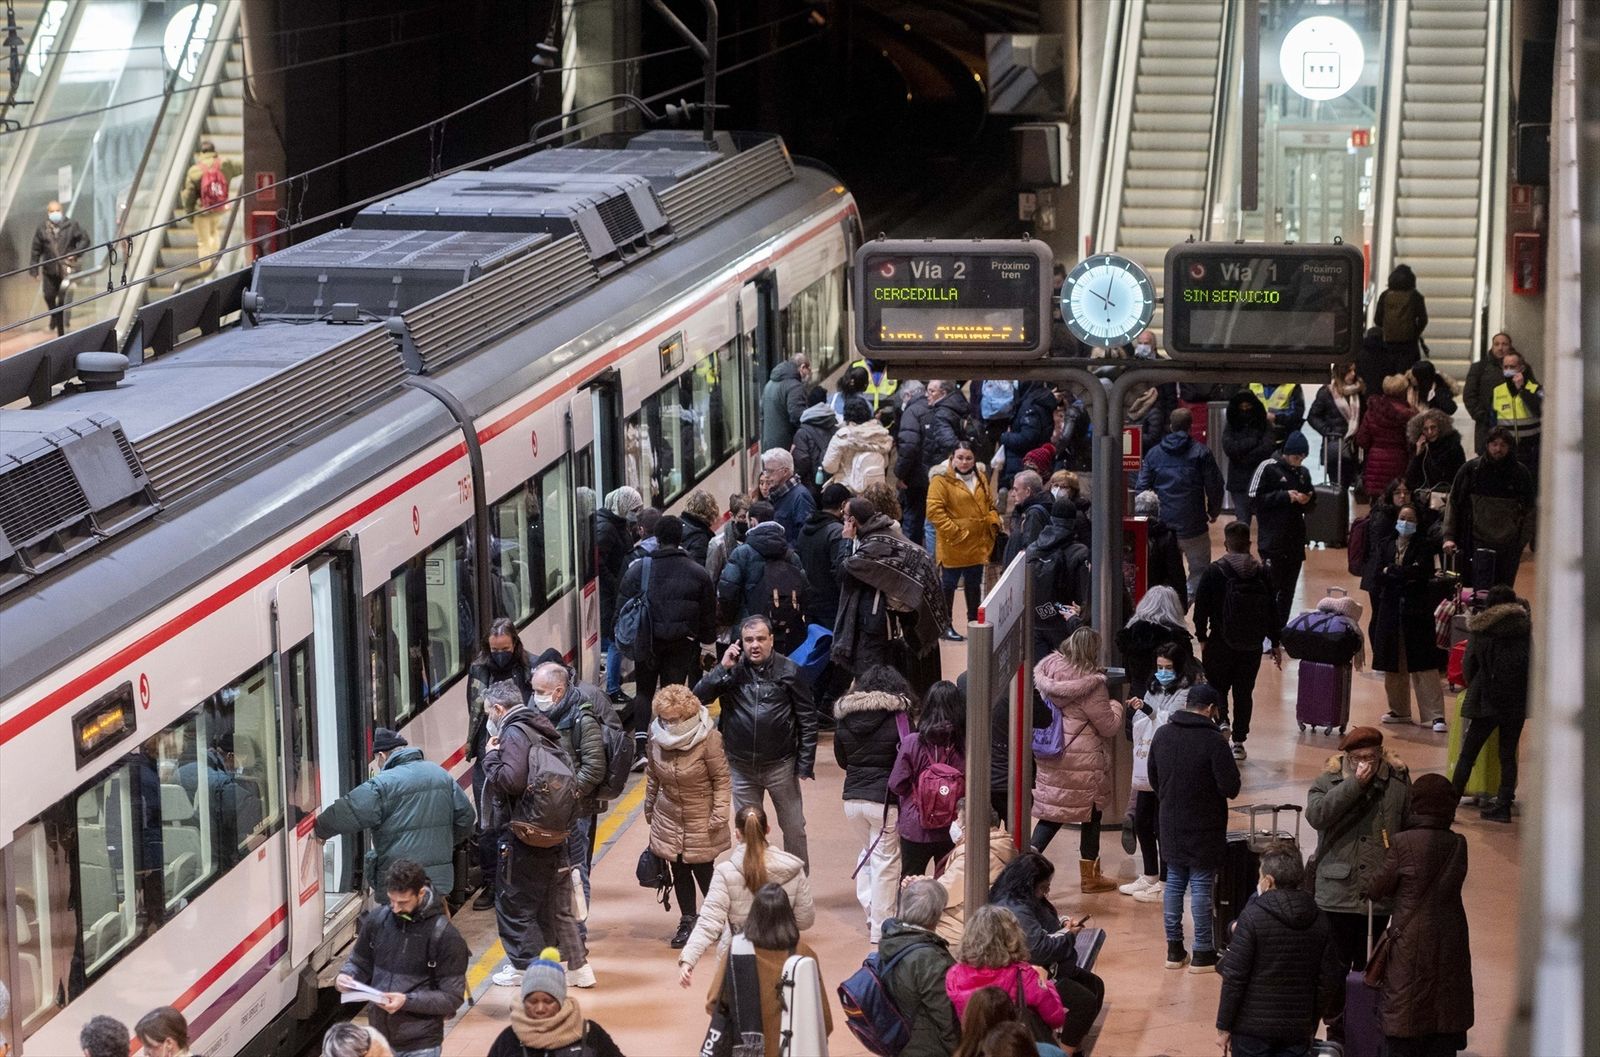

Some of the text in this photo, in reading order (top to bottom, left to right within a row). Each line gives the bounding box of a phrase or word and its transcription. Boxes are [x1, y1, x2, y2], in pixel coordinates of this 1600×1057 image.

[910, 261, 966, 279] Vía 2
[992, 261, 1031, 271] Próximo
[1220, 263, 1278, 281] Vía 1
[1001, 270, 1021, 279] tren
[1313, 274, 1333, 283] tren
[873, 287, 958, 301] CERCEDILLA
[1183, 289, 1280, 304] SIN SERVICIO
[701, 1028, 722, 1057] Pol
